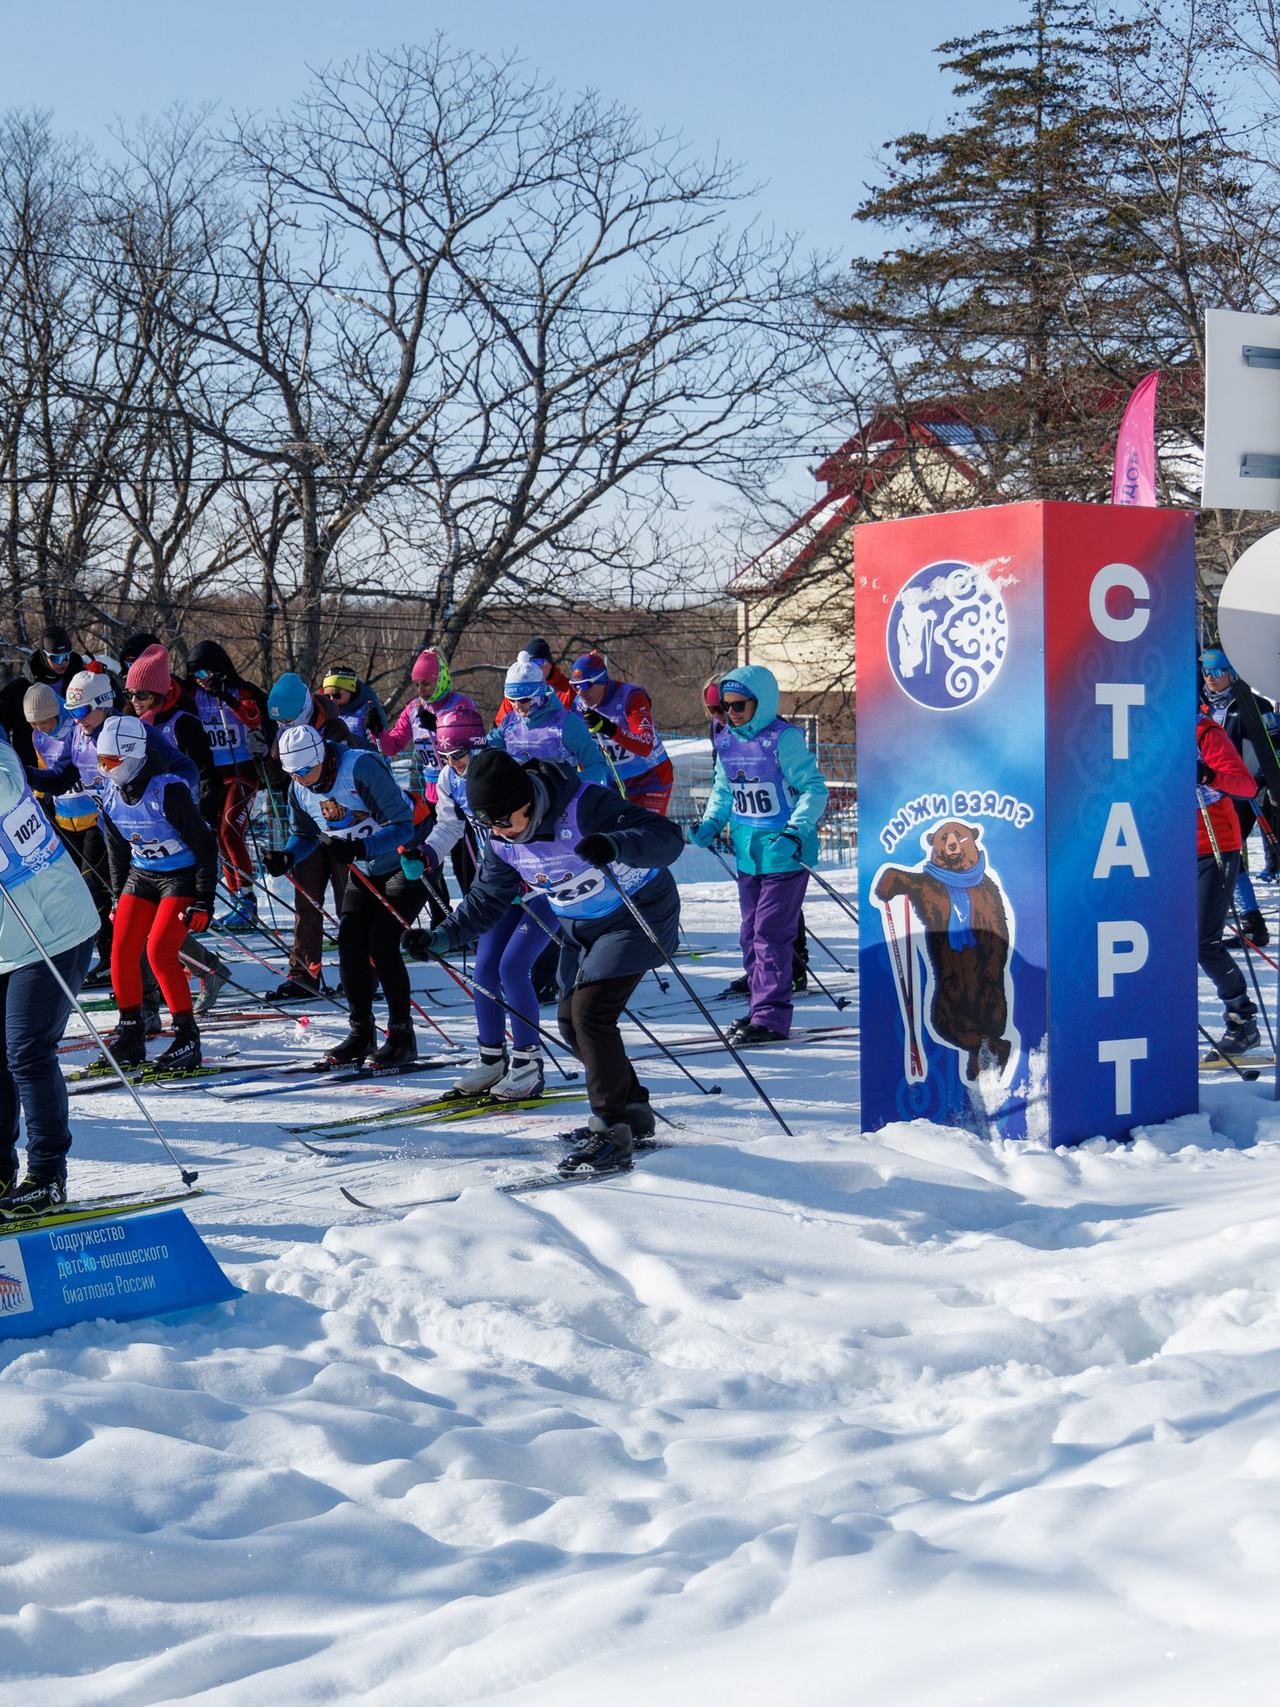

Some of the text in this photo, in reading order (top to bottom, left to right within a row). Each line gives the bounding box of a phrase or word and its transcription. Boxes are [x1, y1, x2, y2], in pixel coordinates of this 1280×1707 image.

[14, 813, 42, 845] 1022
[882, 793, 1032, 851] ЛЫЖИ ВЗЯЛ?
[1089, 563, 1150, 1115] СТАРТ
[142, 1068, 221, 1083] FISCHER
[483, 1102, 519, 1113] FISCHER
[48, 1226, 125, 1253] Содружество
[57, 1245, 169, 1280] детско-юношеского
[62, 1275, 157, 1304] биатлона России
